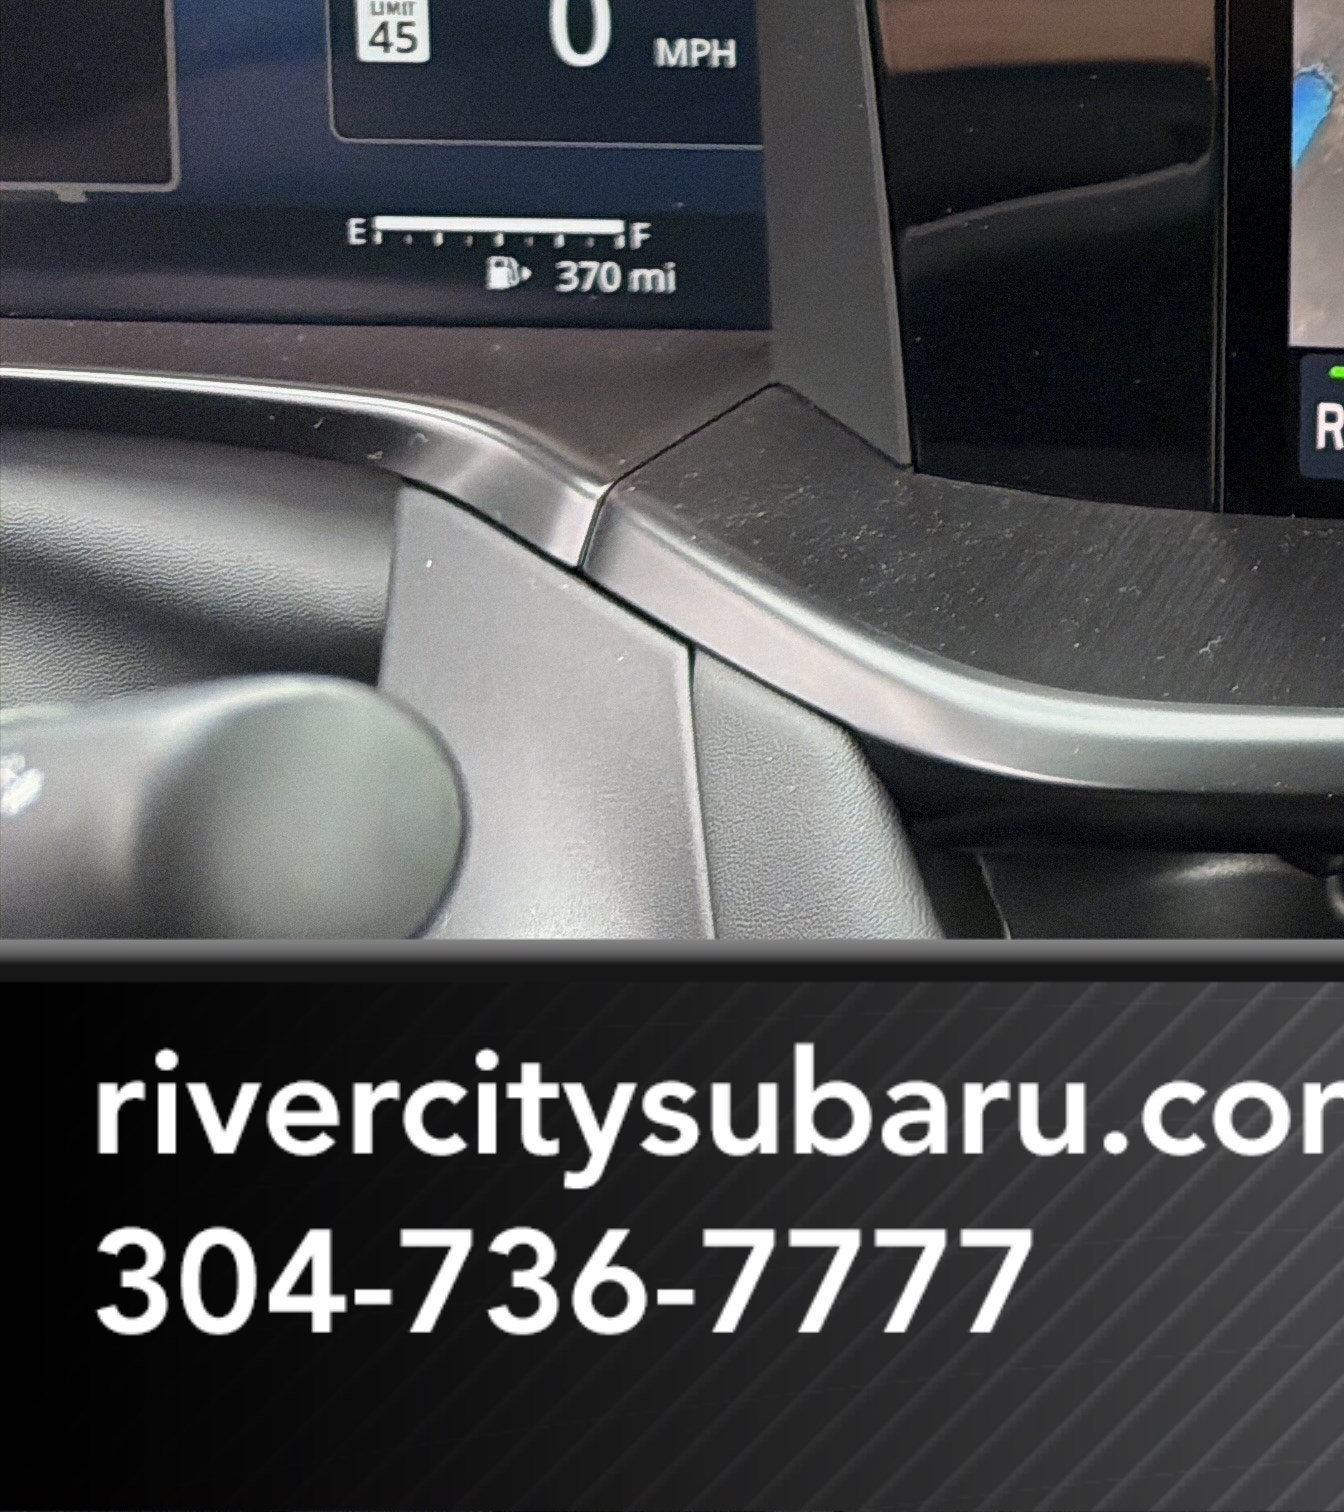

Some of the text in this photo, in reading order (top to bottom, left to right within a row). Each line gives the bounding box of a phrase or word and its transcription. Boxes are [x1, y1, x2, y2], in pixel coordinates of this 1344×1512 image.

[369, 0, 416, 17] LIMIT
[368, 20, 419, 55] 45
[654, 37, 738, 69] MPH
[347, 217, 367, 246] E
[630, 221, 652, 250] F
[555, 260, 677, 294] 370 mi
